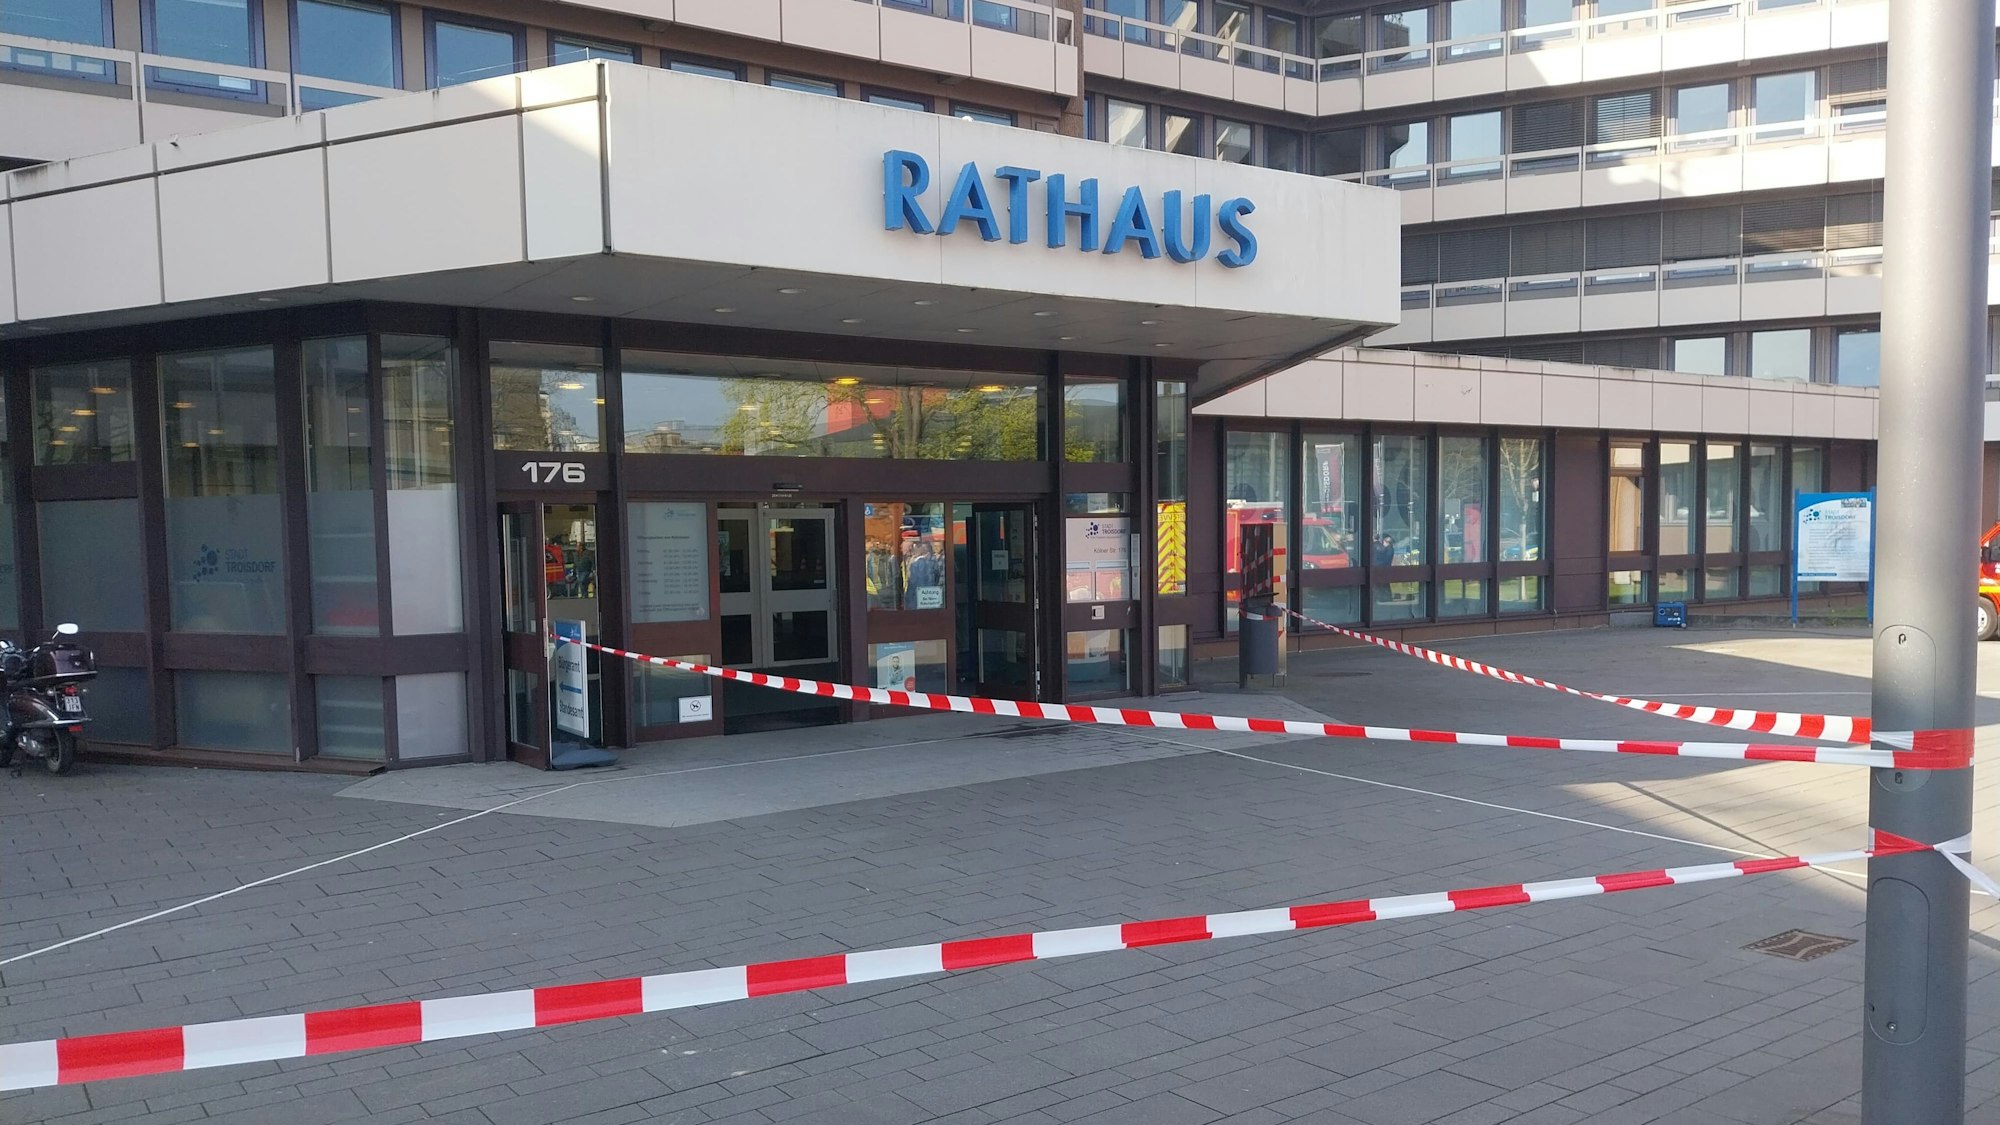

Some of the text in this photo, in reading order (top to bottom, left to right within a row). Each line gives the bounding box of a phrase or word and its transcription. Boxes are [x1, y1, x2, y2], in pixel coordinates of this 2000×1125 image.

[884, 149, 1258, 268] RATHAUS
[521, 461, 586, 483] 176
[225, 561, 276, 573] TROISDORF
[559, 655, 581, 673] Bürgeramt
